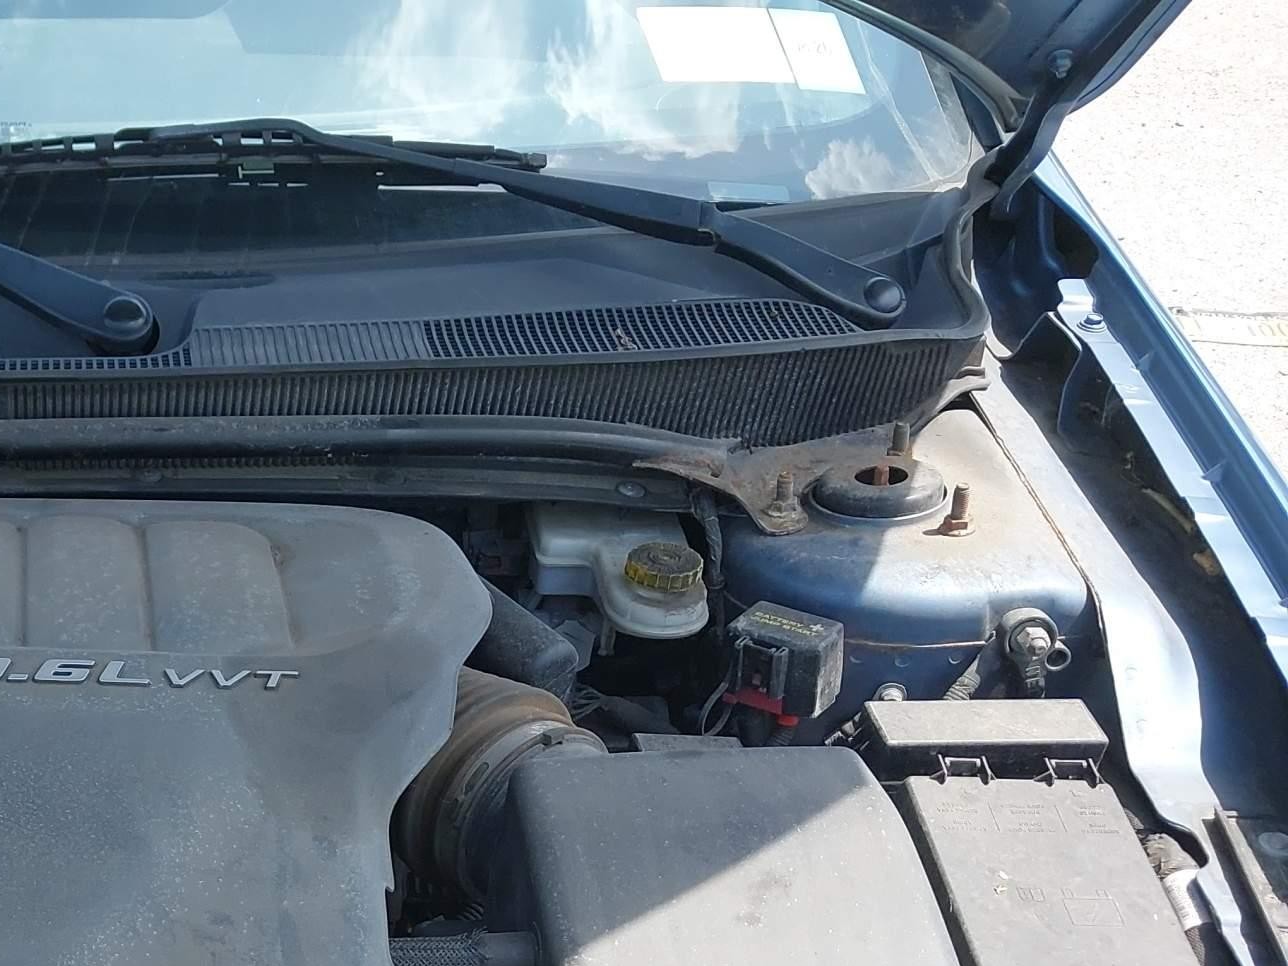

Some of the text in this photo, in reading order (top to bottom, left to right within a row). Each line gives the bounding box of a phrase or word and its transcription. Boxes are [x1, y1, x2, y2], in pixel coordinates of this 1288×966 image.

[750, 616, 817, 636] JUMP START
[754, 611, 804, 627] BATTERY
[163, 668, 301, 691] VVT
